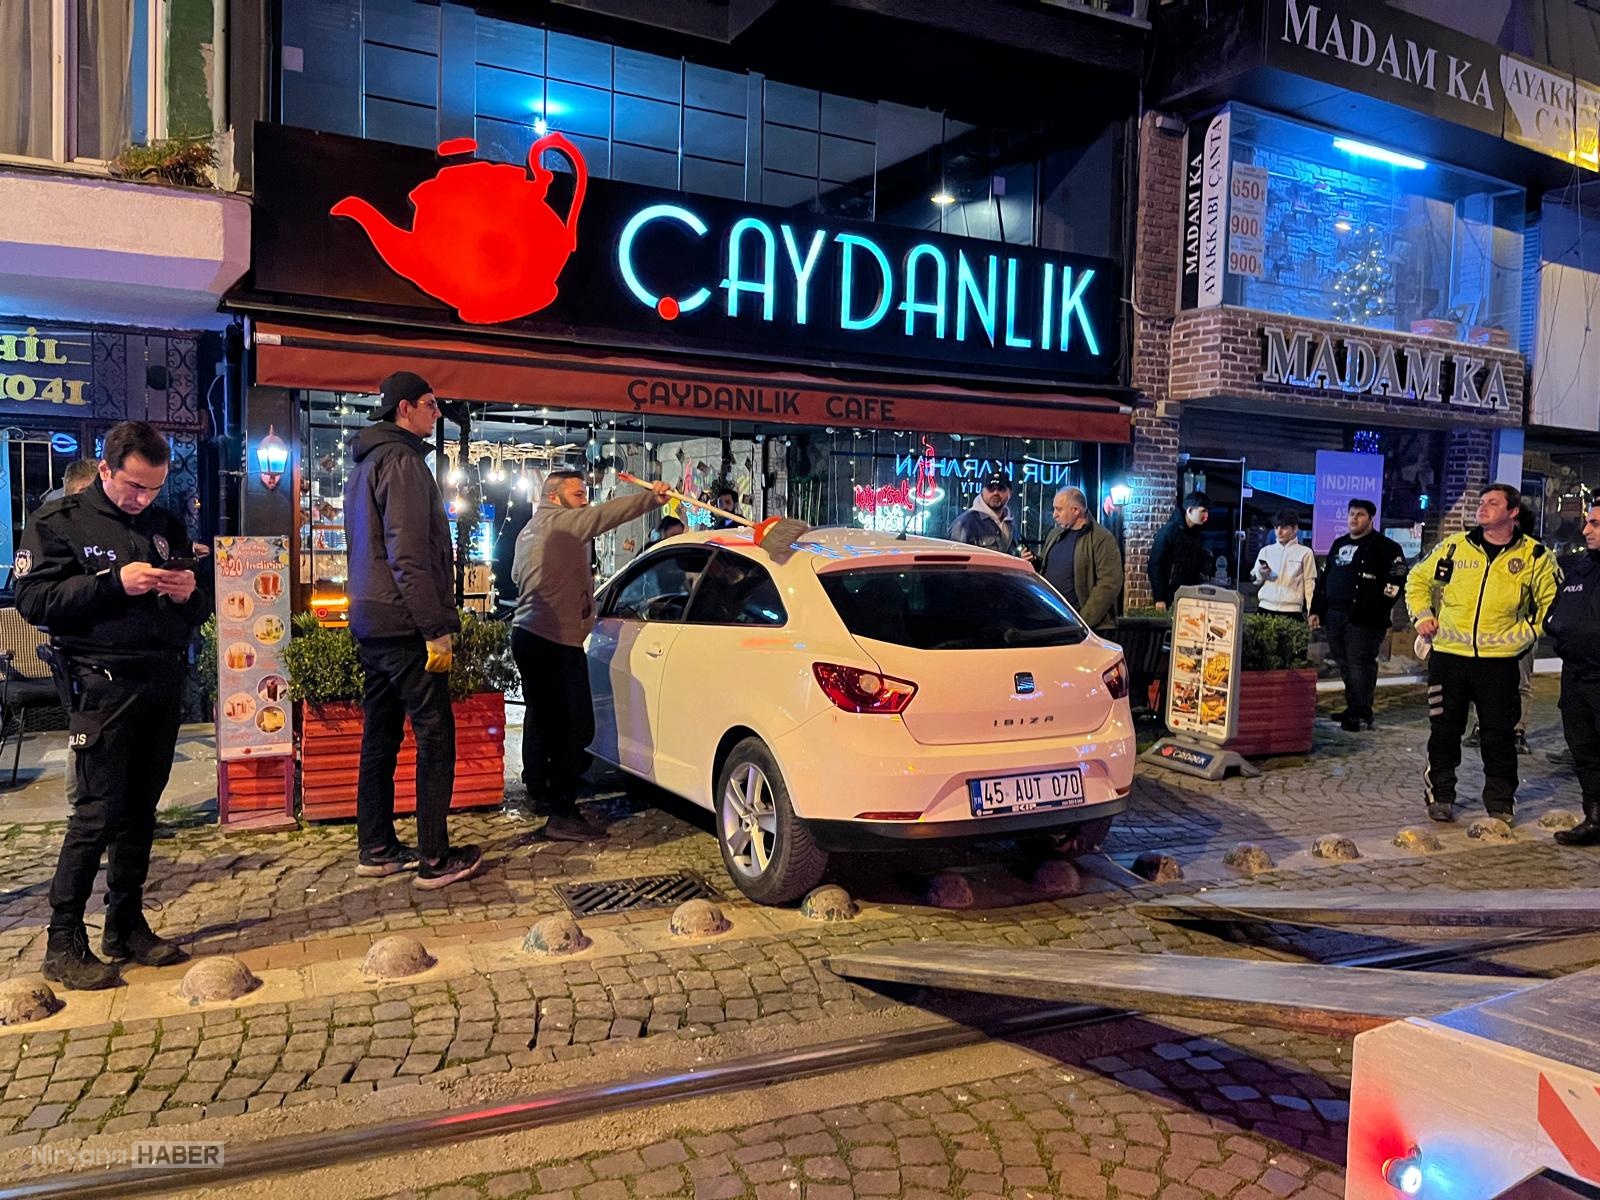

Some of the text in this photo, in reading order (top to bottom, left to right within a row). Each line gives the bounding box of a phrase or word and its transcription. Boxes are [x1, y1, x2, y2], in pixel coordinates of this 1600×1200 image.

[1280, 0, 1495, 111] MADAM KA
[1185, 153, 1203, 275] MADAM KA
[1205, 119, 1222, 295] AYAKKABI ÇANTA
[618, 204, 1100, 355] ÇAYDANLIK
[627, 379, 896, 421] ÇAYDANLIK CAFE
[1263, 326, 1510, 411] MADAM KA
[993, 715, 1054, 727] IBIZA
[984, 773, 1080, 806] 45 AUT 070
